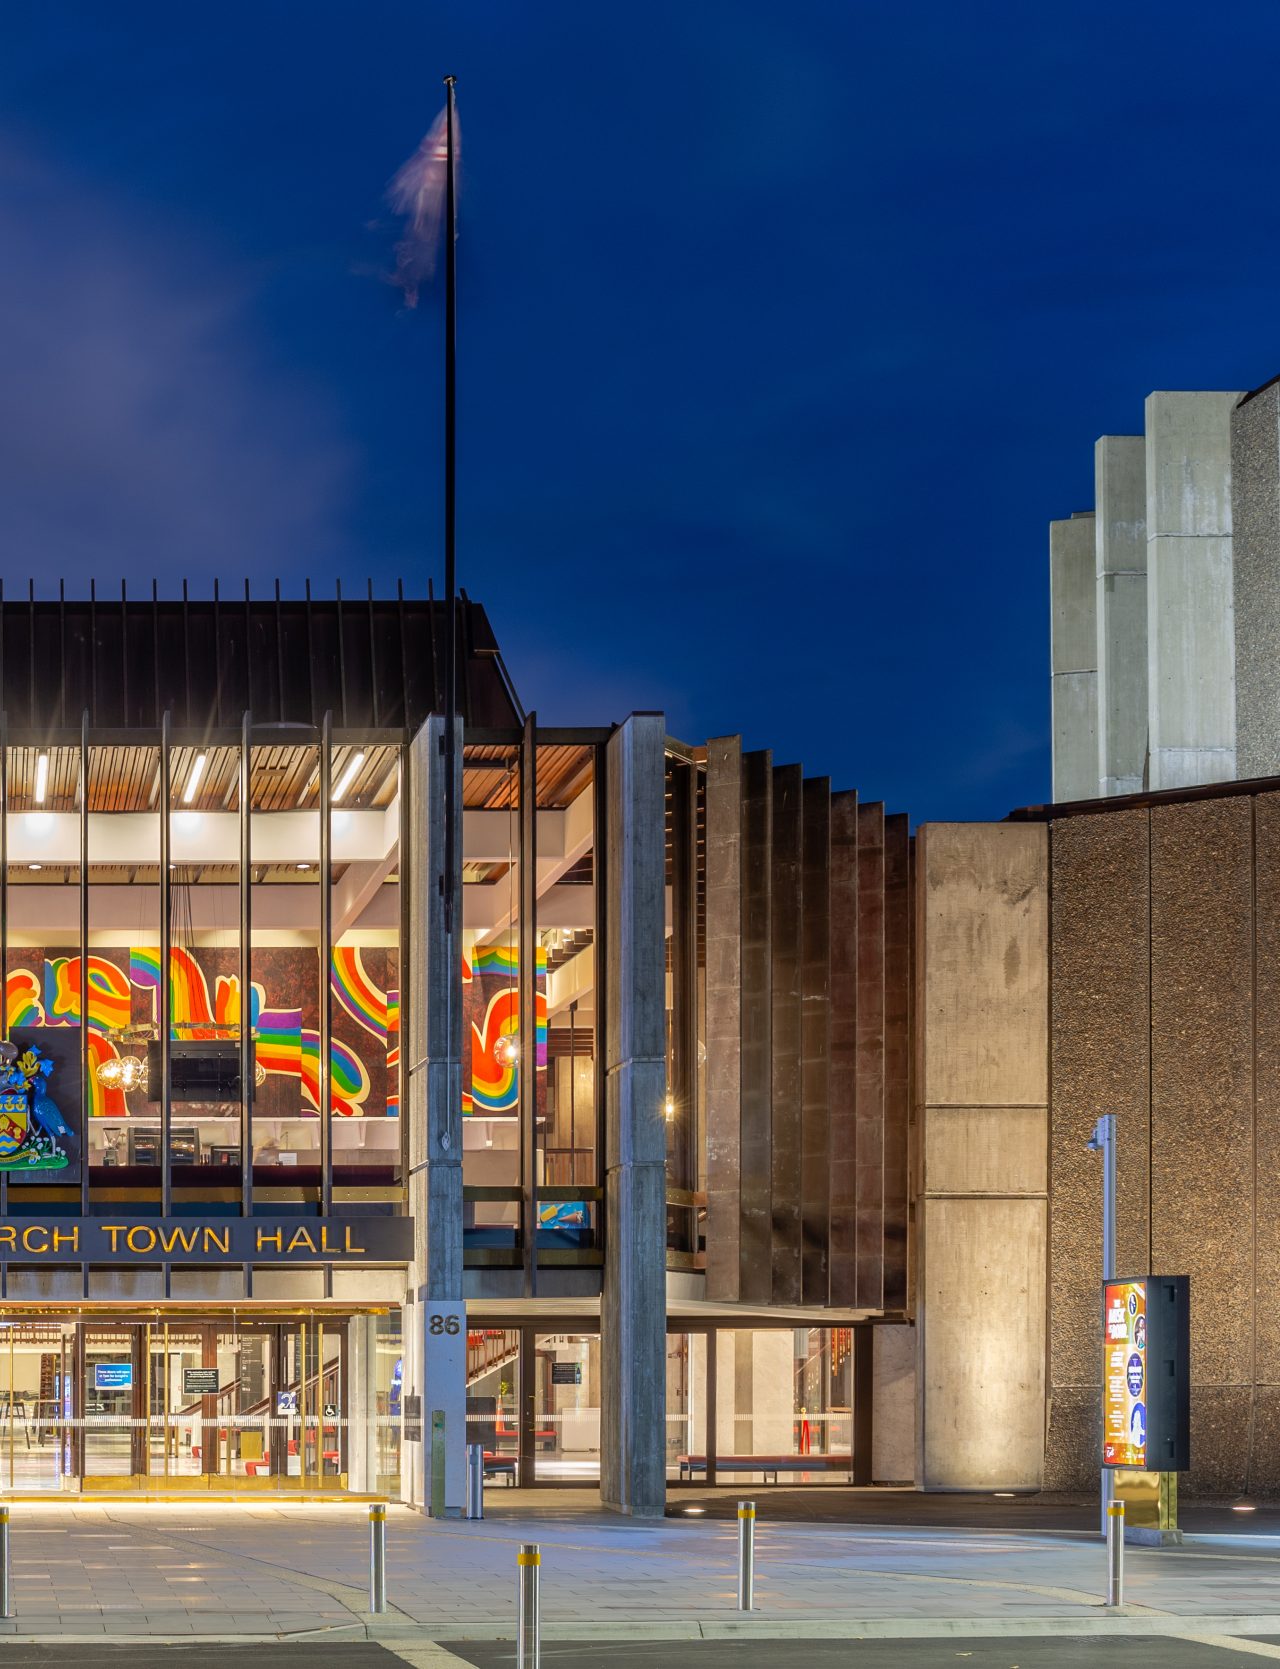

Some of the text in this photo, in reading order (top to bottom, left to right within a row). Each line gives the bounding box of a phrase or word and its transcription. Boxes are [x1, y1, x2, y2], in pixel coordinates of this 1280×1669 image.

[101, 1225, 229, 1253] TOWN
[256, 1225, 366, 1253] HALL
[429, 1314, 460, 1336] 86
